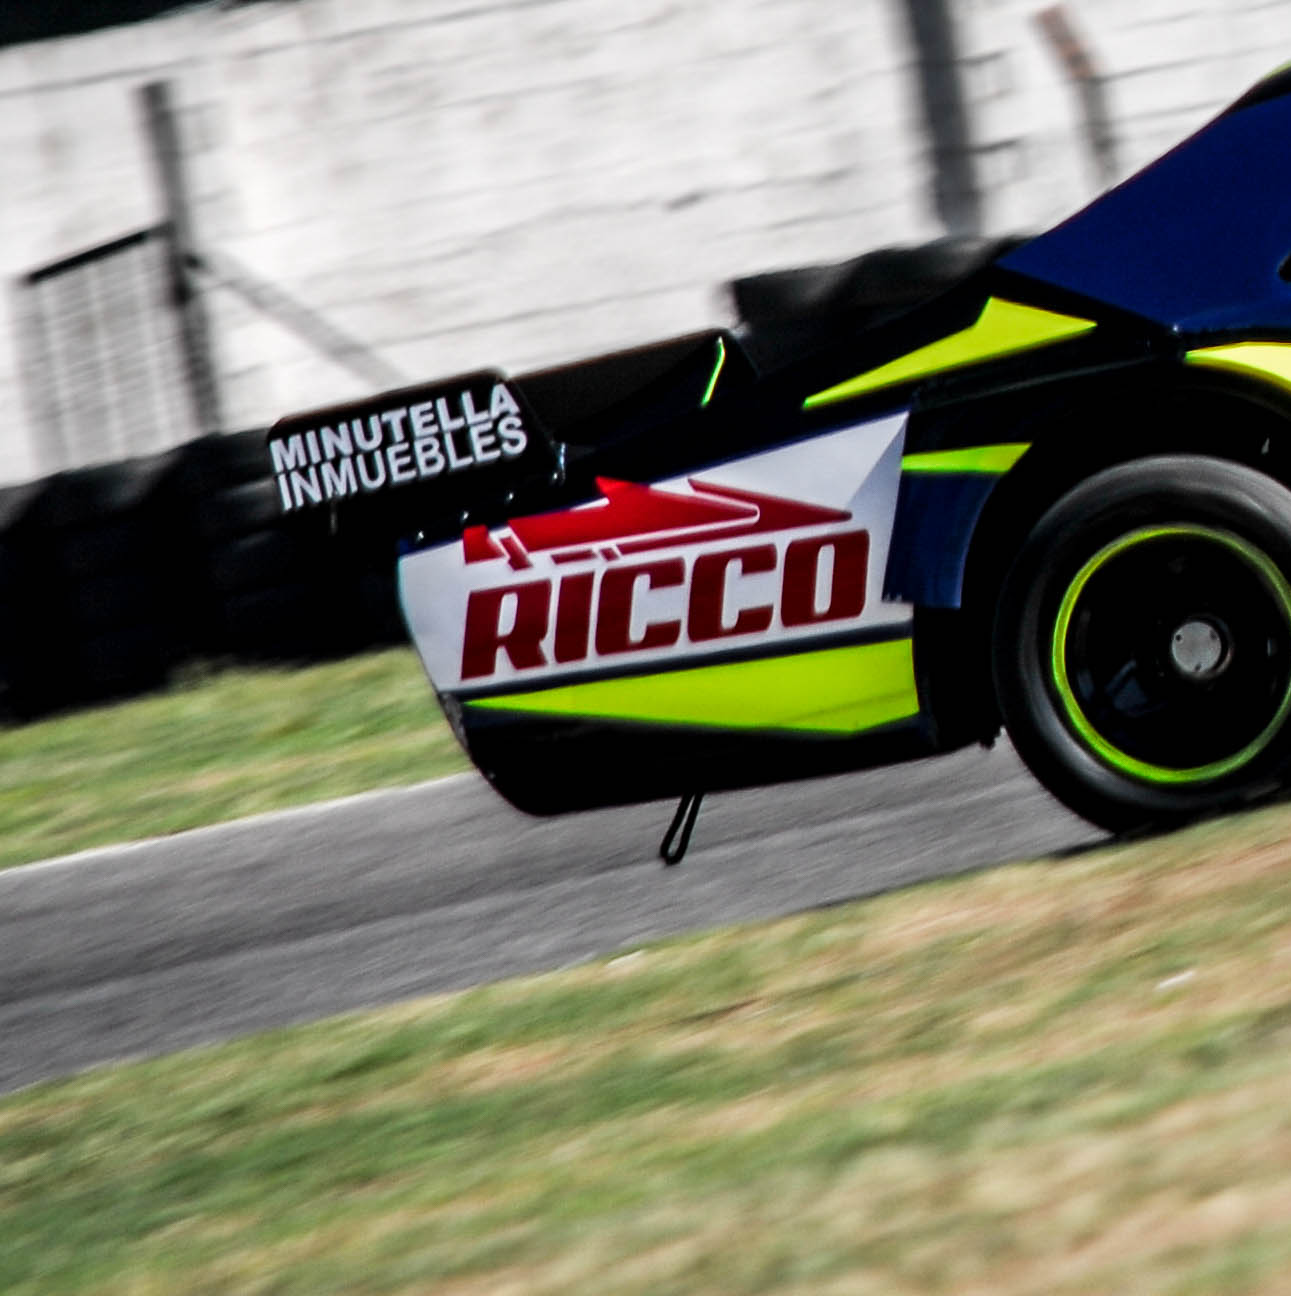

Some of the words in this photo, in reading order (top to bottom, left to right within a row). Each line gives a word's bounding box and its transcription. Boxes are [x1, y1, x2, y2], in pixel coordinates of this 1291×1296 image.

[269, 383, 521, 473] MINUTELLA
[277, 416, 528, 512] INMUEBLES
[460, 529, 869, 681] RICCO
